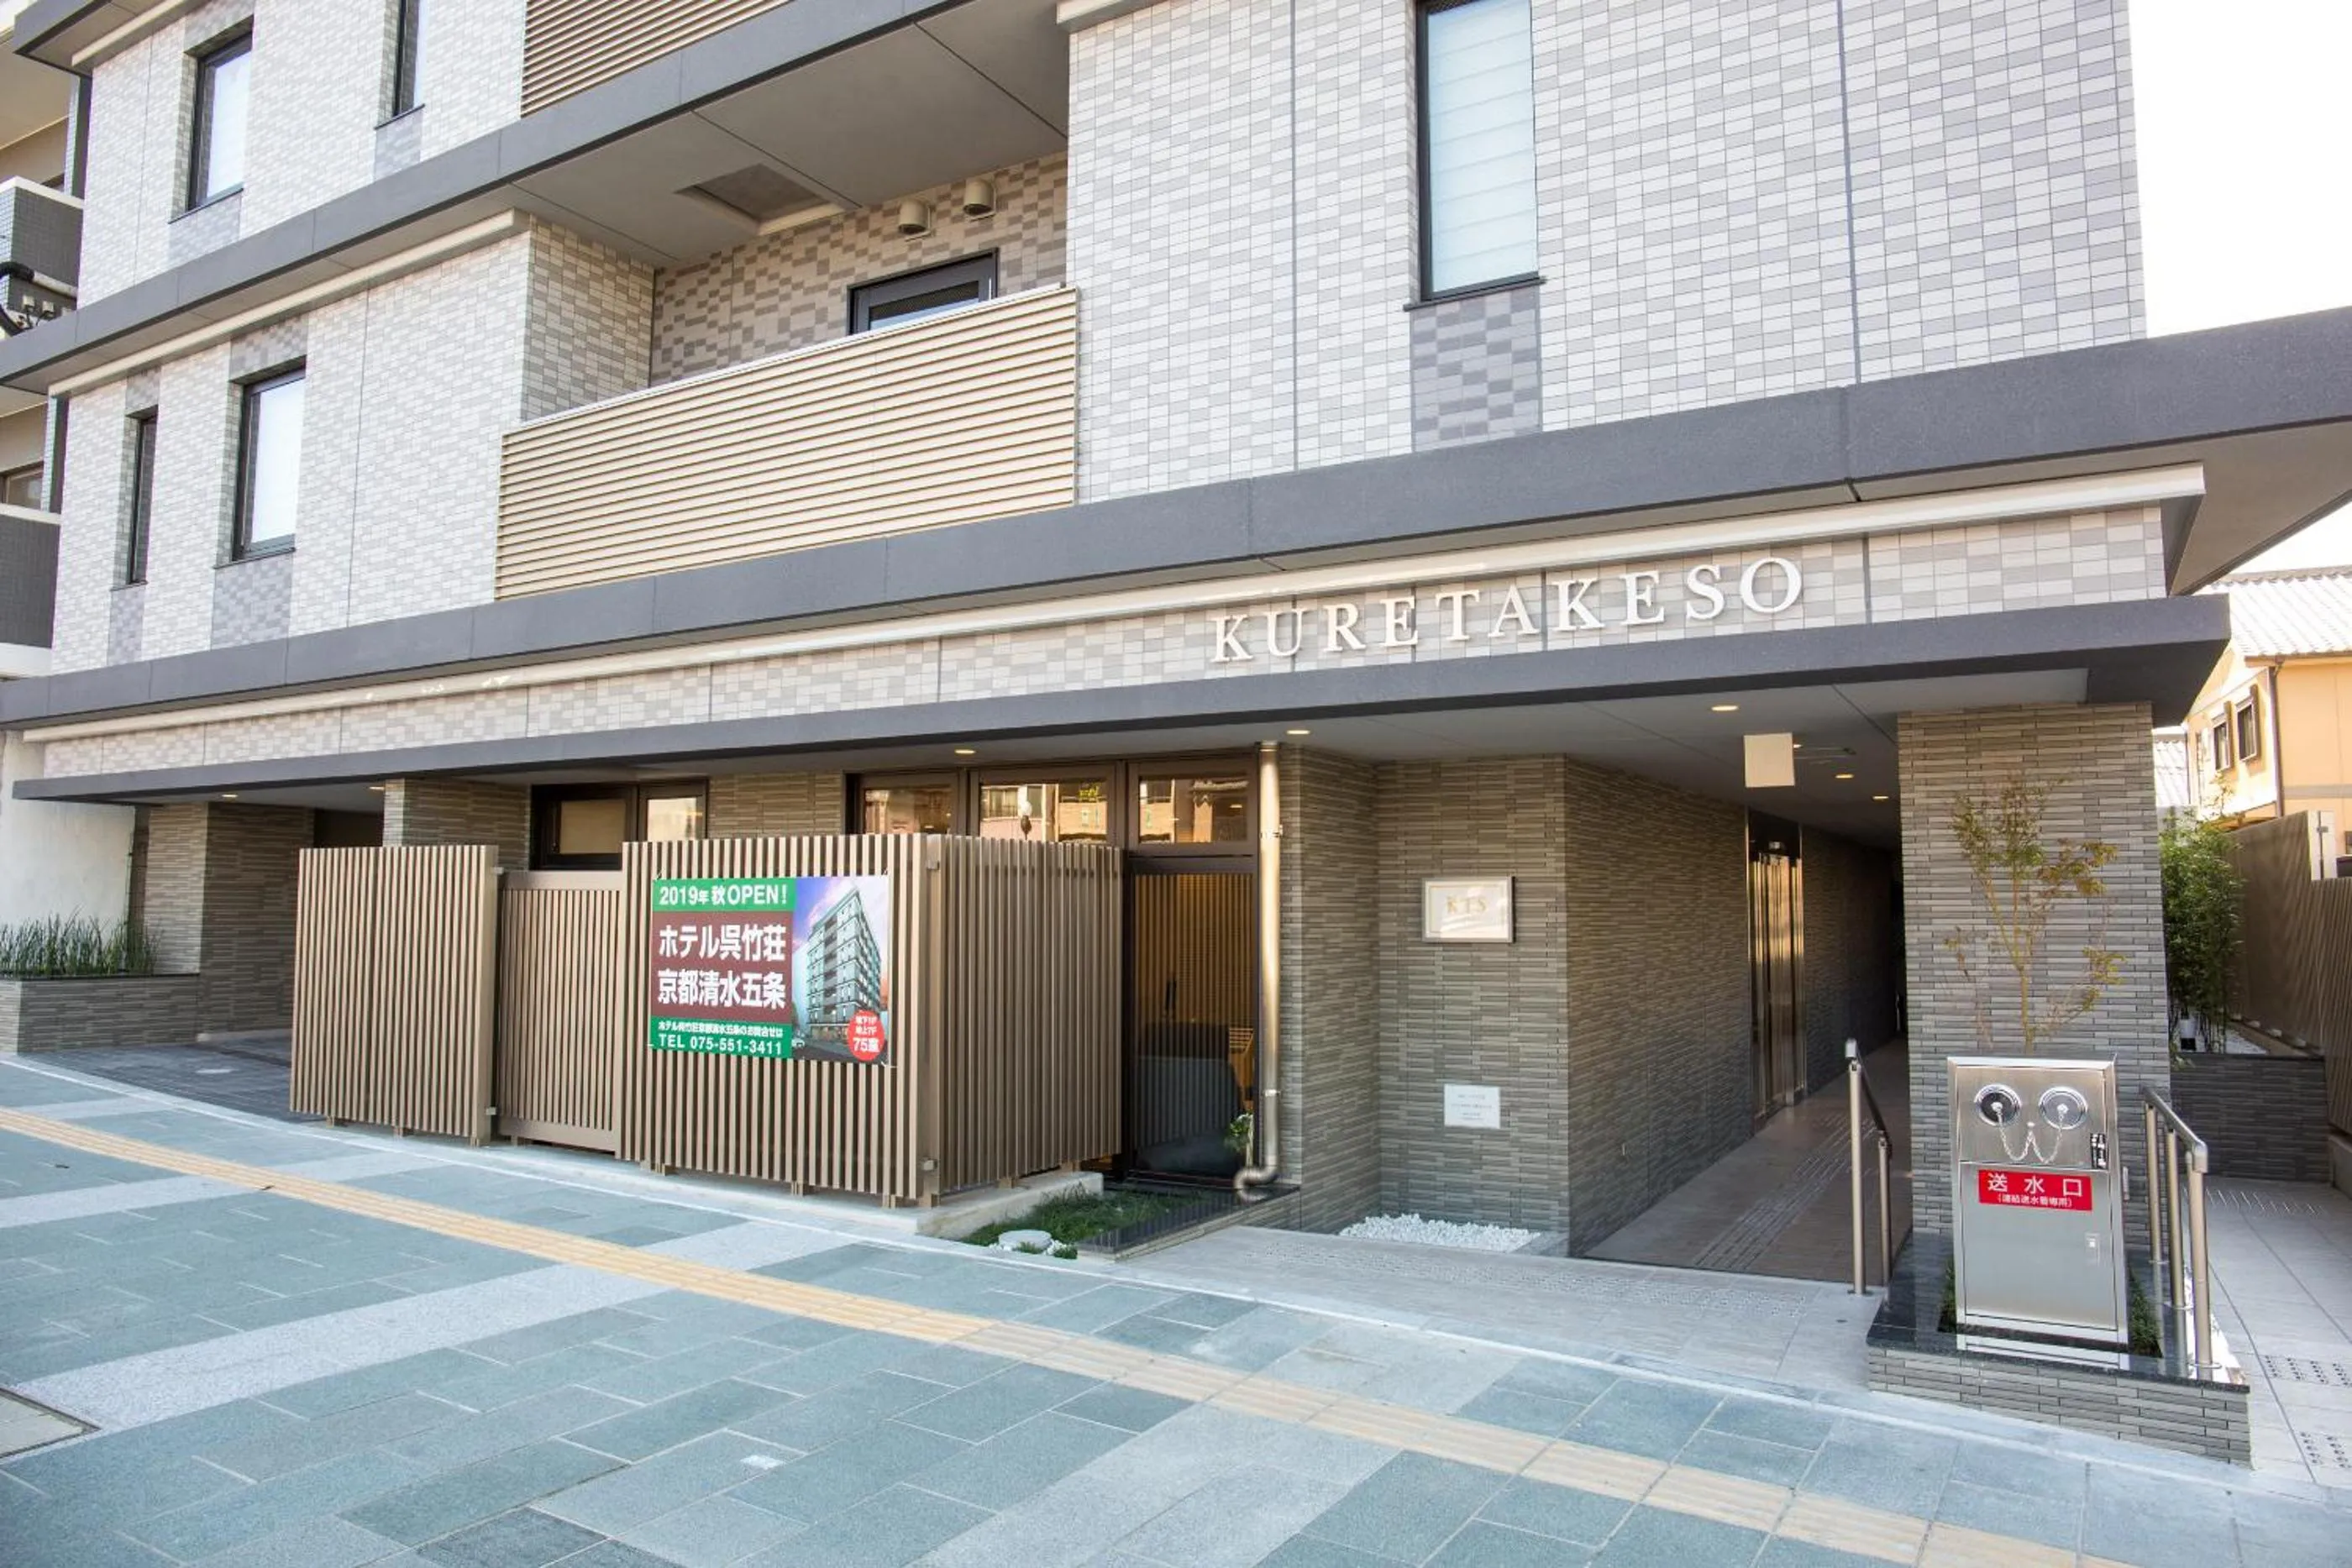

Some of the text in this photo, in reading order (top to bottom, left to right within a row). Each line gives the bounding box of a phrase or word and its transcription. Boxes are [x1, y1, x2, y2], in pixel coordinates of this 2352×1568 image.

[1210, 557, 1803, 663] KURETAKESO
[659, 925, 787, 962] ホテル呉竹荘
[658, 968, 785, 1009] 京都清水五条
[659, 1034, 685, 1048] TEL
[1987, 1172, 2082, 1197] 送水口
